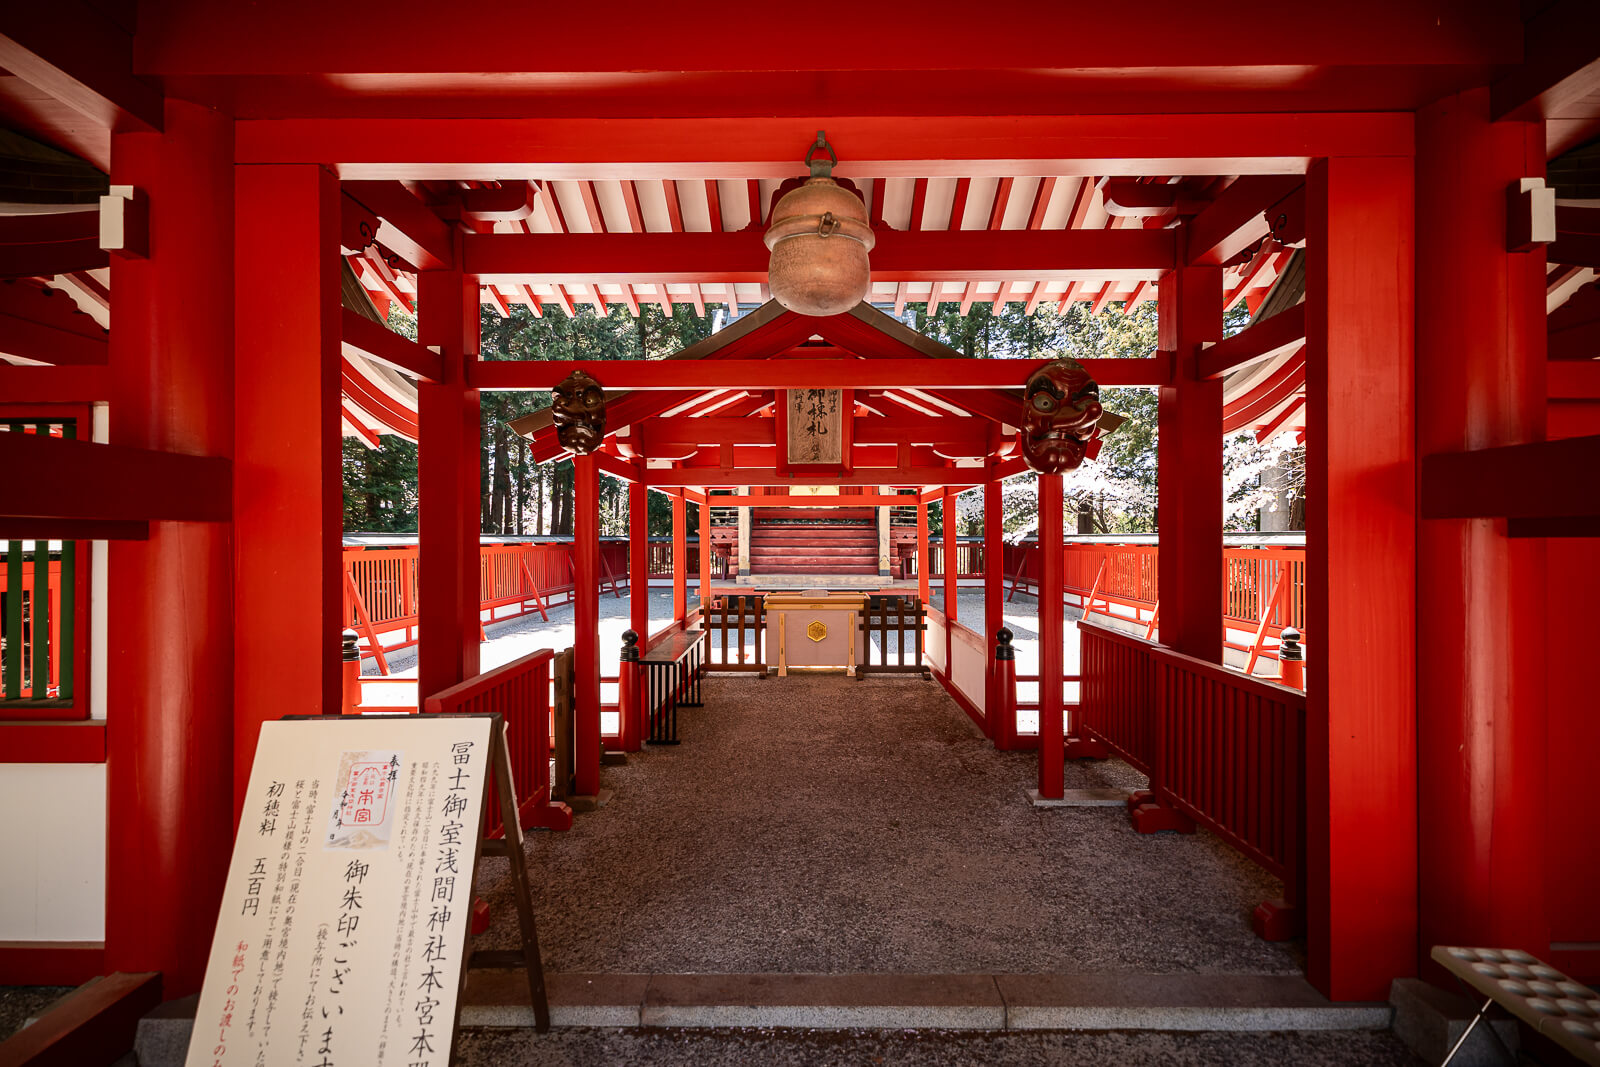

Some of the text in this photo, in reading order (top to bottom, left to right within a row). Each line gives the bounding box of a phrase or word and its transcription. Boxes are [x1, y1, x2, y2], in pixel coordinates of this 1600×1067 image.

[241, 781, 285, 916] 初穂料 五百円
[353, 788, 375, 823] 本宮
[408, 741, 475, 1067] 冨士御室浅間神社本宮本
